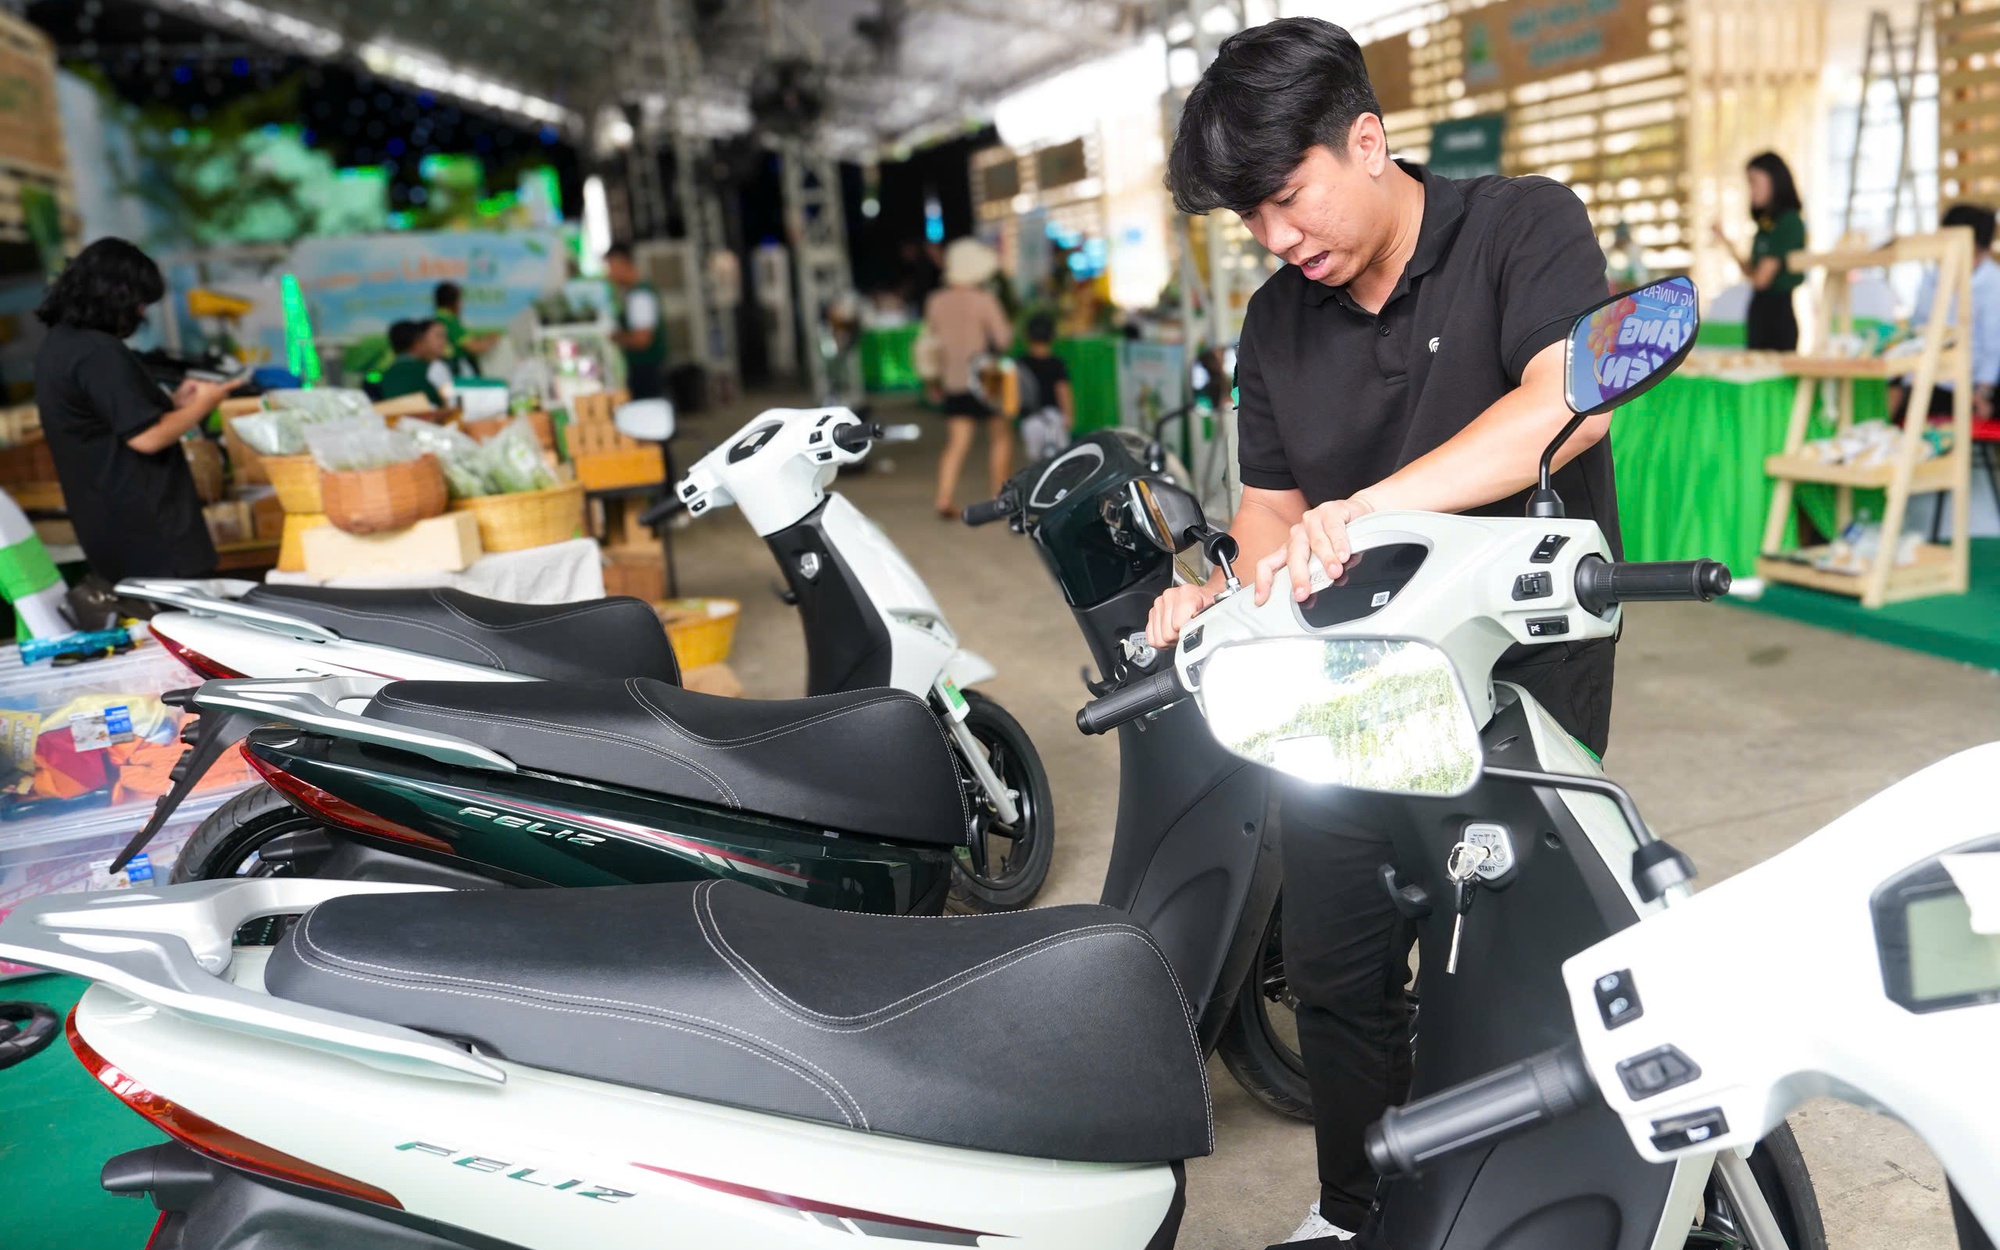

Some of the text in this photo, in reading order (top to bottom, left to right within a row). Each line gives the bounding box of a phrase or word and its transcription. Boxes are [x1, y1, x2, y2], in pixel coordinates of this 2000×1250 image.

[458, 806, 607, 847] FELIZ
[1478, 865, 1496, 873] START
[395, 1140, 638, 1204] FELIZ
